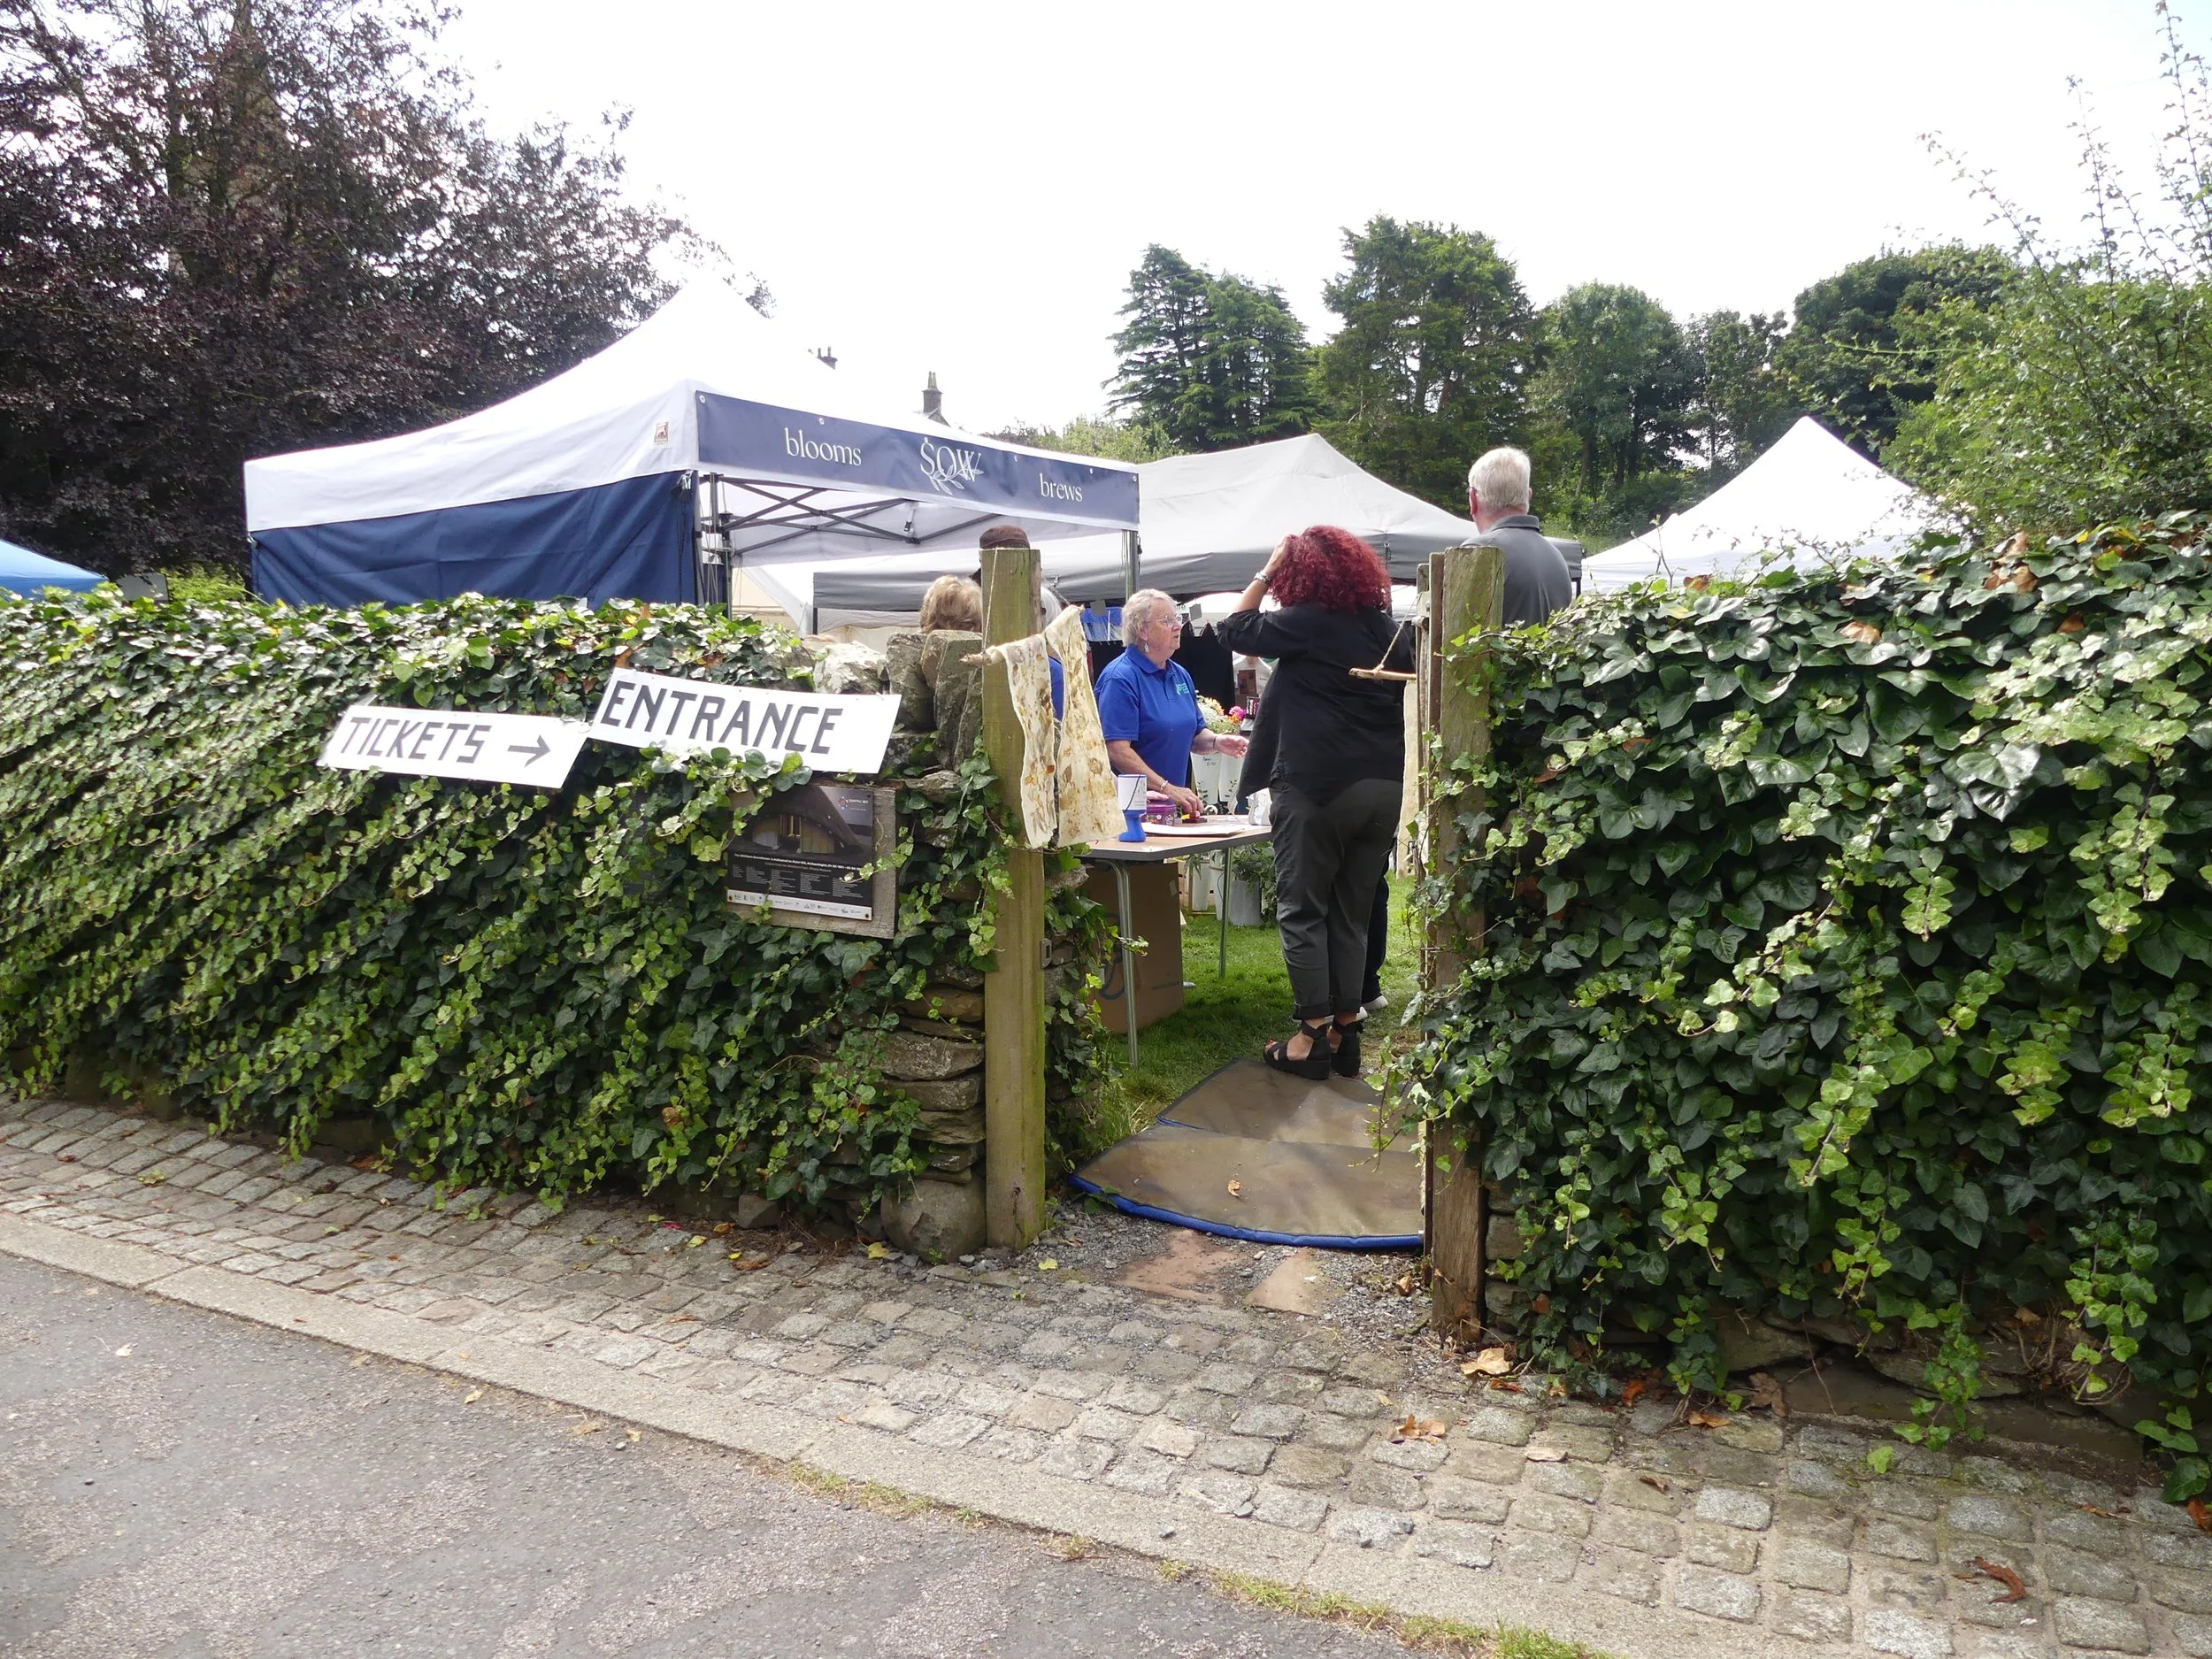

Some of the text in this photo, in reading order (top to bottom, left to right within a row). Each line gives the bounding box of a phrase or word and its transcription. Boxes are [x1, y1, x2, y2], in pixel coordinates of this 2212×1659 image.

[784, 426, 1083, 502] blooms SOW brews
[341, 717, 492, 764] TICKETS
[600, 680, 844, 755] ENTRANCE
